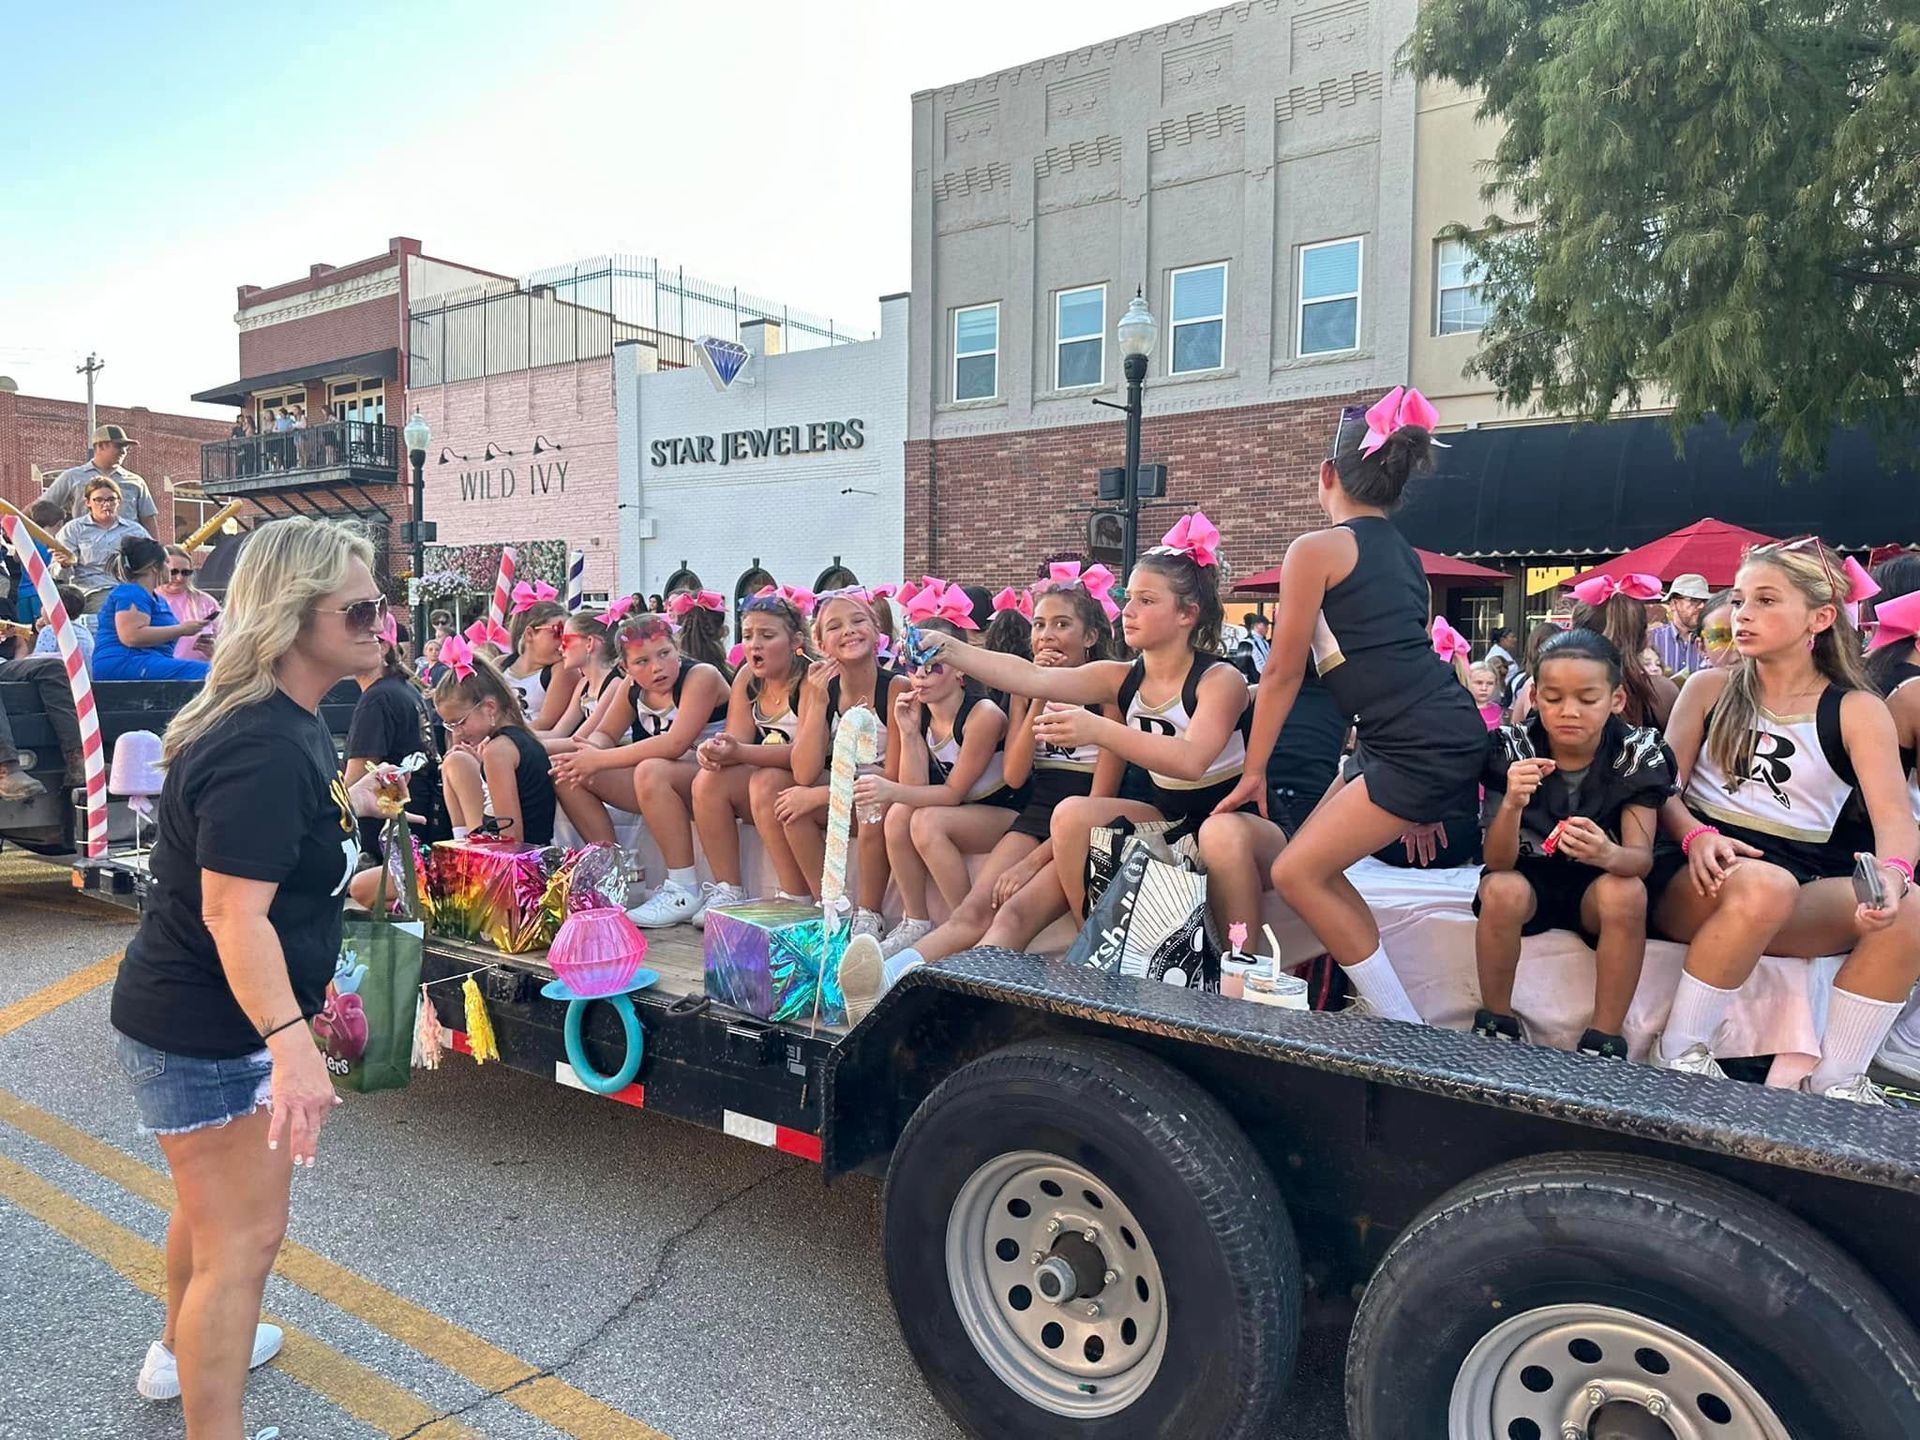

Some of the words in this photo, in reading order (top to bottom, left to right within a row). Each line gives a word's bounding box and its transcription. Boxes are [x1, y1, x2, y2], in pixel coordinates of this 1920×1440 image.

[650, 435, 716, 468] STAR
[719, 418, 865, 466] JEWELERS
[460, 467, 515, 501] WILD
[530, 461, 568, 495] IVY
[1084, 890, 1135, 969] rshll
